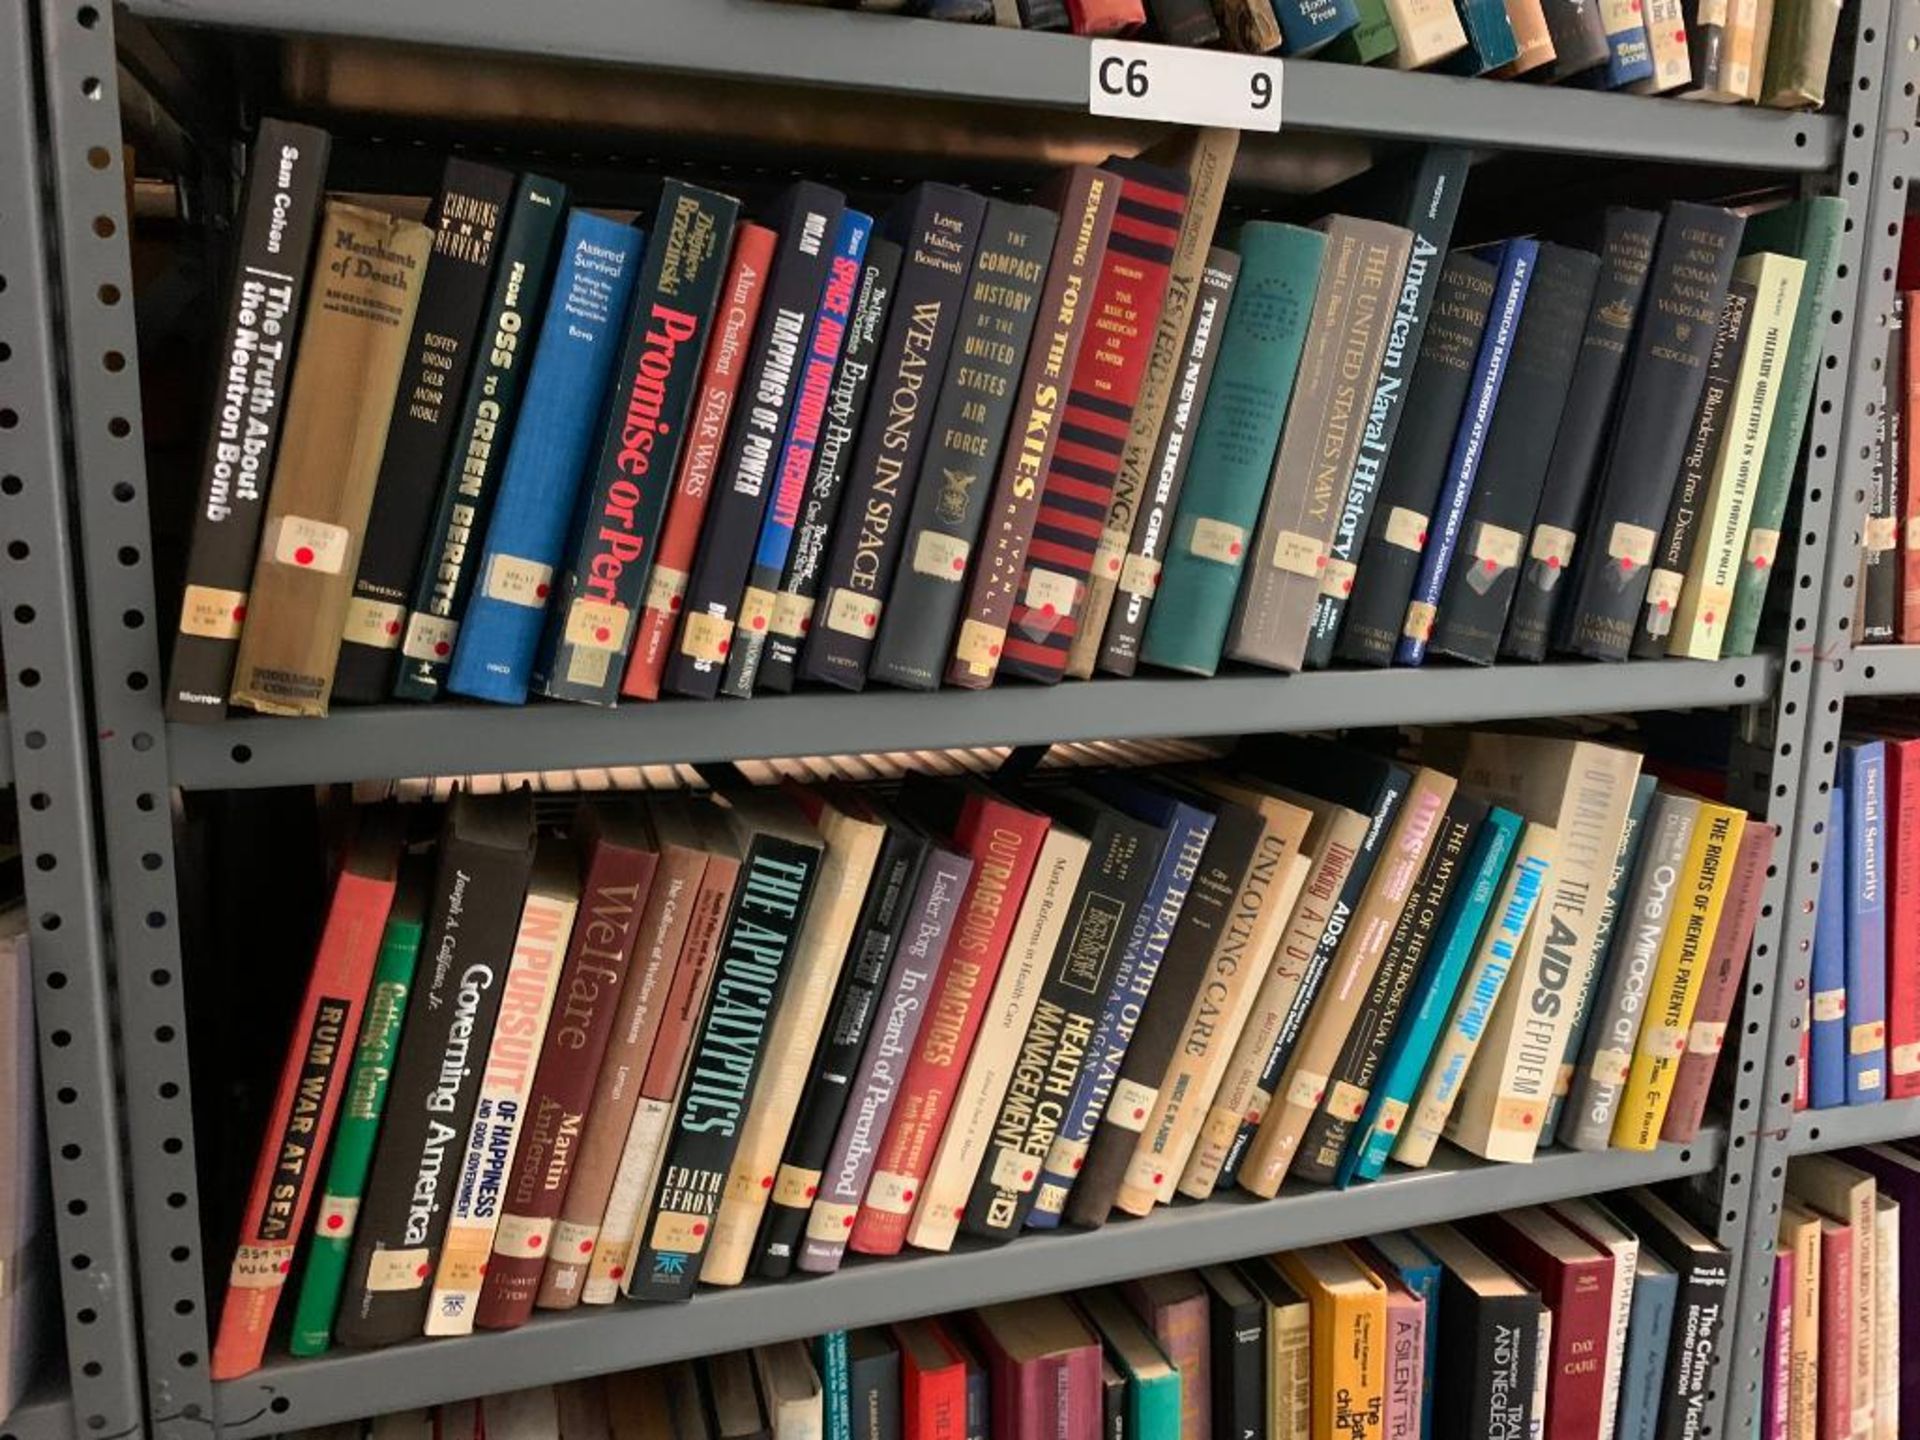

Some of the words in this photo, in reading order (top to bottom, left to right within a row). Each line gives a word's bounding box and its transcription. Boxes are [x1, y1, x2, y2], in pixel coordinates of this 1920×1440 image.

[1310, 6, 1337, 26] Press
[1098, 57, 1149, 98] C6
[1250, 72, 1273, 110] 9
[278, 145, 299, 189] Sam
[267, 192, 291, 254] Cohen
[335, 230, 417, 270] Merchants
[657, 194, 700, 297] Brzezinski
[799, 211, 828, 257] NOLAN
[933, 212, 964, 234] Long
[1007, 230, 1028, 247] THE
[331, 258, 349, 279] of
[354, 258, 409, 291] Death
[573, 254, 623, 278] Survival
[577, 239, 626, 264] Assured
[978, 251, 1042, 284] COMPACT
[1368, 244, 1390, 294] THE
[239, 280, 266, 326] the
[505, 261, 525, 307] FROM
[733, 263, 757, 307] Alun
[823, 255, 860, 318] SPACE
[973, 281, 1032, 313] HISTORY
[1057, 274, 1083, 326] FOR
[1383, 233, 1438, 370] American
[262, 286, 292, 337] The
[813, 315, 844, 359] AND
[1193, 297, 1218, 359] THE
[1343, 294, 1377, 381] UNITED
[1493, 278, 1523, 346] AMERICAN
[424, 332, 458, 351] BOFFEY
[491, 310, 522, 370] OSS
[714, 307, 749, 376] Chalfont
[756, 308, 805, 408] TRAPPINGS
[963, 335, 1015, 366] UNITED
[1044, 330, 1070, 380] THE
[220, 326, 260, 439] Neutron
[248, 340, 283, 415] Truth
[483, 375, 499, 395] TO
[616, 303, 698, 476] Promise
[791, 359, 833, 444] NATIONAL
[828, 358, 868, 421] Empty
[882, 300, 942, 453] WEAPONS
[957, 366, 1007, 398] STATES
[1173, 361, 1202, 429] NEW
[1478, 346, 1506, 419] BATTLESHIP
[409, 404, 438, 423] NOBLE
[701, 387, 734, 435] STAR
[750, 406, 780, 434] OF
[960, 401, 987, 423] AIR
[1323, 383, 1356, 466] STATES
[1362, 371, 1402, 452] Naval
[1473, 420, 1483, 437] AT
[1685, 386, 1725, 469] Blundering
[236, 415, 270, 501] About
[458, 400, 500, 497] GREEN
[733, 432, 773, 498] POWER
[812, 417, 852, 499] Promise
[944, 429, 989, 458] FORCE
[1012, 383, 1059, 501] SKIES
[1155, 430, 1183, 502] HIGH
[207, 441, 240, 522] Bomb
[686, 440, 716, 499] WARS
[772, 443, 815, 529] SECURITY
[871, 454, 904, 498] IN
[1308, 468, 1337, 523] NAVY
[1453, 479, 1466, 508] AND
[1683, 468, 1702, 504] Into
[604, 480, 640, 528] or
[1333, 459, 1380, 561] History
[1448, 508, 1459, 536] WAR
[430, 503, 476, 615] BERETS
[849, 498, 893, 592] SPACE
[1668, 507, 1694, 566] Disaster
[1002, 534, 1024, 594] IVAN
[1566, 769, 1617, 870] O'MALLEY
[1864, 766, 1879, 827] Social
[1173, 827, 1209, 881] THE
[1448, 821, 1470, 852] THE
[1708, 815, 1731, 842] THE
[741, 855, 808, 920] THE
[958, 828, 1022, 955] OUTRAGEOUS
[1308, 841, 1355, 901] Thinking
[1433, 859, 1456, 906] MYTH
[1696, 842, 1723, 893] RIGHTS
[1861, 825, 1879, 904] Security
[450, 870, 471, 914] Joseph
[1215, 835, 1287, 978] UNLOVING
[1391, 891, 1423, 942] MICHAEL
[1419, 907, 1435, 929] OF
[1550, 878, 1590, 916] THE
[1644, 865, 1676, 920] One
[1691, 893, 1708, 918] OF
[445, 913, 460, 929] A.
[521, 905, 563, 941] IN
[1114, 901, 1154, 987] LEONARD
[1130, 885, 1186, 997] HEALTH
[1317, 900, 1351, 952] AIDS:
[1680, 915, 1706, 969] MENTAL
[556, 883, 640, 1050] Welfare
[903, 968, 928, 992] In
[1016, 959, 1034, 1000] Health
[1371, 930, 1428, 1048] HETEROSEXUAL
[1530, 914, 1578, 1023] AIDS
[1619, 923, 1664, 1015] Miracle
[487, 945, 554, 1094] PURSUIT
[923, 958, 981, 1067] PRACTICES
[1107, 990, 1122, 1006] A.
[1115, 1002, 1141, 1042] OF
[1184, 982, 1229, 1058] CARE
[1664, 968, 1692, 1028] PATIENTS
[310, 1006, 344, 1066] RUM
[425, 963, 494, 1113] Governing
[681, 917, 788, 1137] APOCALYPTICS
[879, 991, 919, 1066] Search
[1085, 1010, 1114, 1072] SAGAN
[1614, 1017, 1634, 1043] at
[872, 1059, 894, 1087] of
[993, 999, 1065, 1152] MANAGEMENT
[1044, 1012, 1094, 1098] HEALTH
[1356, 1051, 1379, 1087] AIDS
[295, 1075, 326, 1134] WAR
[350, 1066, 390, 1120] Grant
[479, 1098, 493, 1120] AND
[497, 1100, 518, 1124] OF
[471, 1119, 489, 1150] GOOD
[517, 1095, 561, 1204] Anderson
[545, 1111, 583, 1191] Martin
[835, 1084, 887, 1197] Parenthood
[1024, 1101, 1063, 1158] CARE
[280, 1141, 307, 1176] AT
[404, 1119, 456, 1246] America
[456, 1149, 483, 1220] GOVERNMENT
[474, 1124, 514, 1219] HAPPINESS
[664, 1165, 723, 1194] EDITH
[262, 1183, 296, 1239] SEA
[659, 1189, 721, 1215] EFRON
[1397, 1320, 1411, 1336] A
[1492, 1324, 1513, 1371] AND
[1571, 1340, 1595, 1356] DAY
[1684, 1304, 1700, 1349] SECOND
[1702, 1304, 1719, 1338] The
[1393, 1339, 1411, 1402] SILENT
[1564, 1359, 1598, 1377] CARE
[1677, 1348, 1693, 1396] EDITION
[1690, 1339, 1713, 1391] Crime
[1336, 1388, 1350, 1430] child
[1366, 1396, 1382, 1425] the
